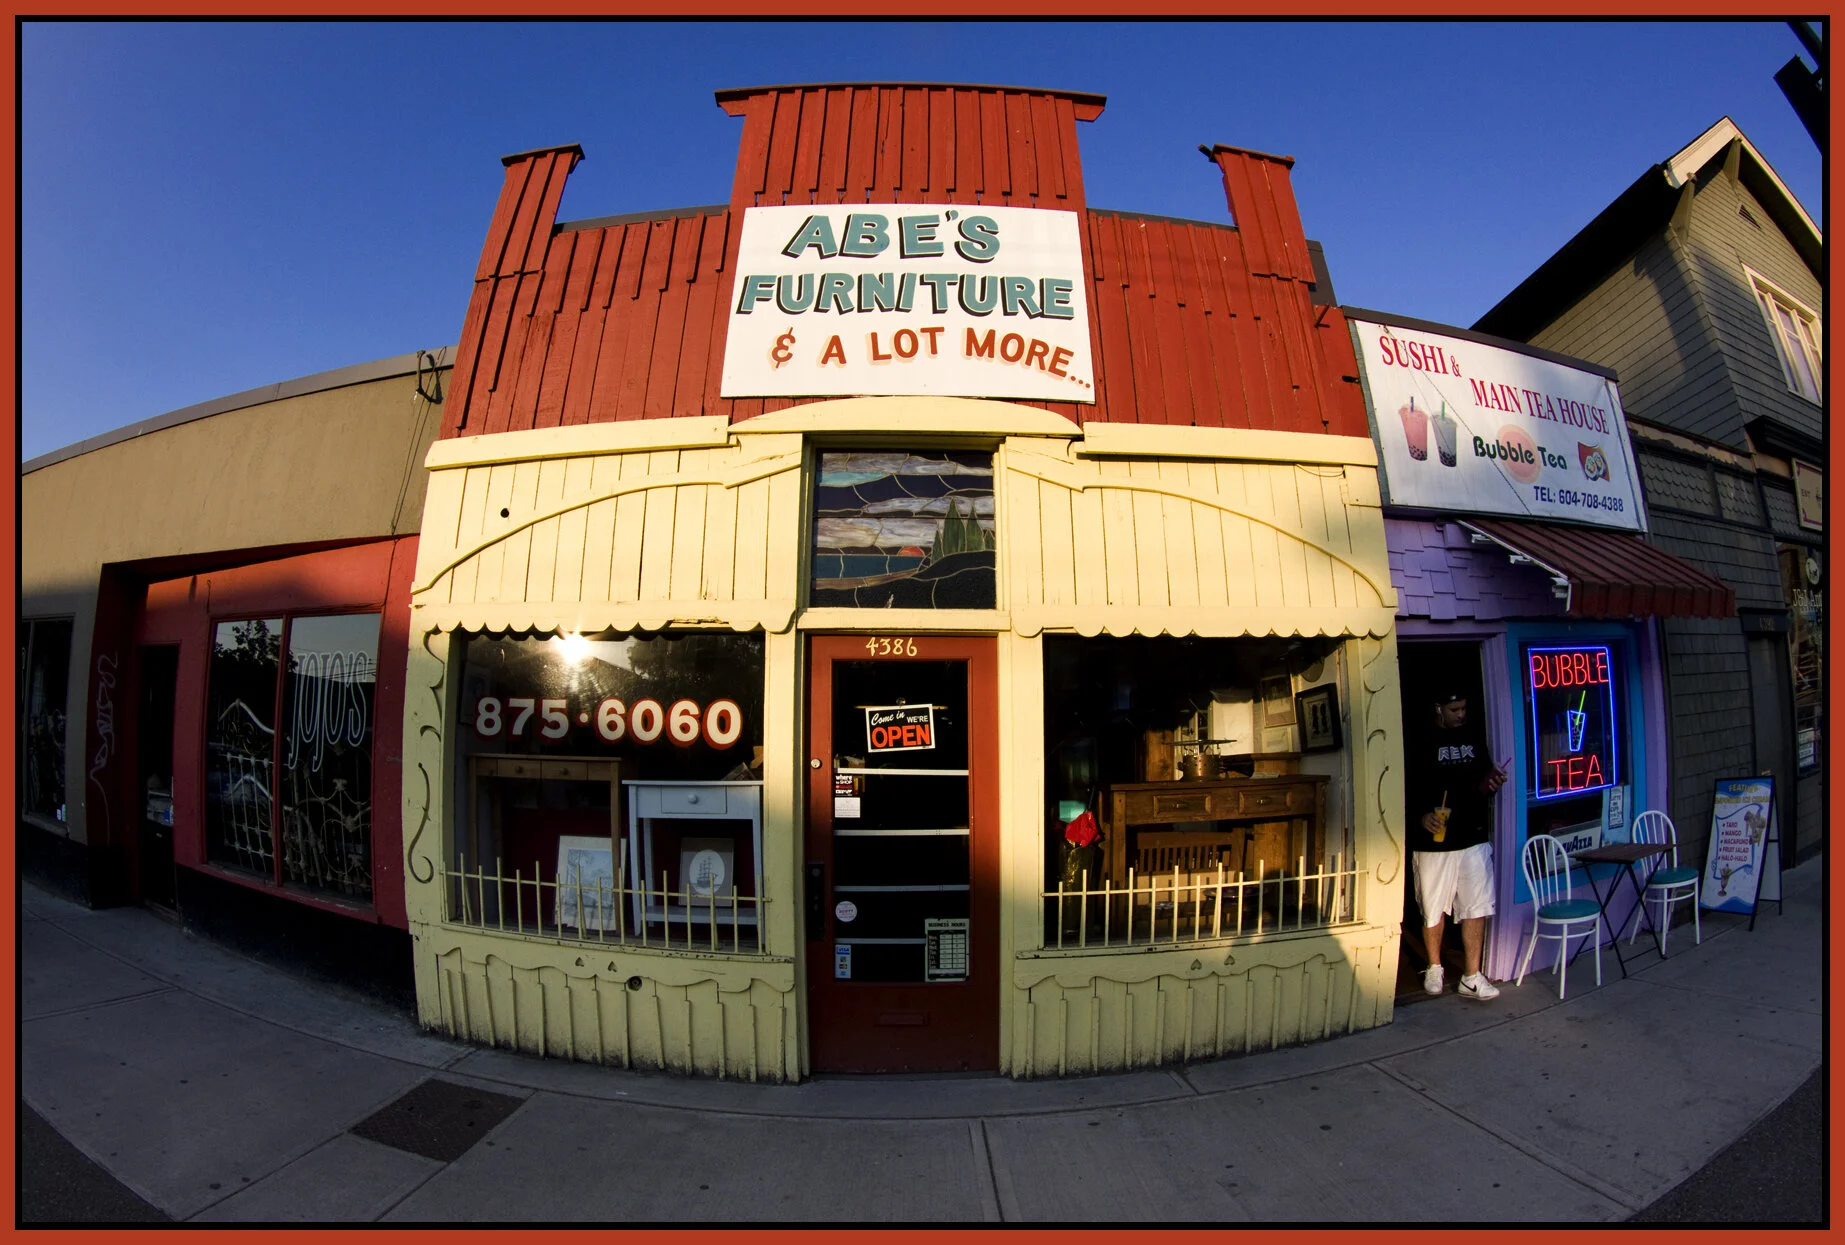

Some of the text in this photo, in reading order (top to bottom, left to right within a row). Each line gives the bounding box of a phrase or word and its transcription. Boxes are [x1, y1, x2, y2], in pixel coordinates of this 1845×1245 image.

[781, 210, 1000, 263] ABE'S
[736, 272, 1075, 320] FURNITURE
[819, 334, 847, 369] A
[867, 327, 945, 367] LOT
[963, 327, 1091, 390] MORE...
[1379, 335, 1462, 378] SUSHI &
[1469, 378, 1610, 435] MAIN TEA HOUSE
[1473, 436, 1568, 470] Bubble Tea
[1534, 486, 1624, 513] TEL: 604-708-4388
[865, 637, 918, 656] 4386
[1531, 652, 1609, 689] BUBBLE
[288, 650, 369, 772] JOJO'S
[871, 713, 894, 726] Come
[896, 711, 906, 720] in
[871, 724, 931, 748] OPEN
[1548, 755, 1604, 793] TEA
